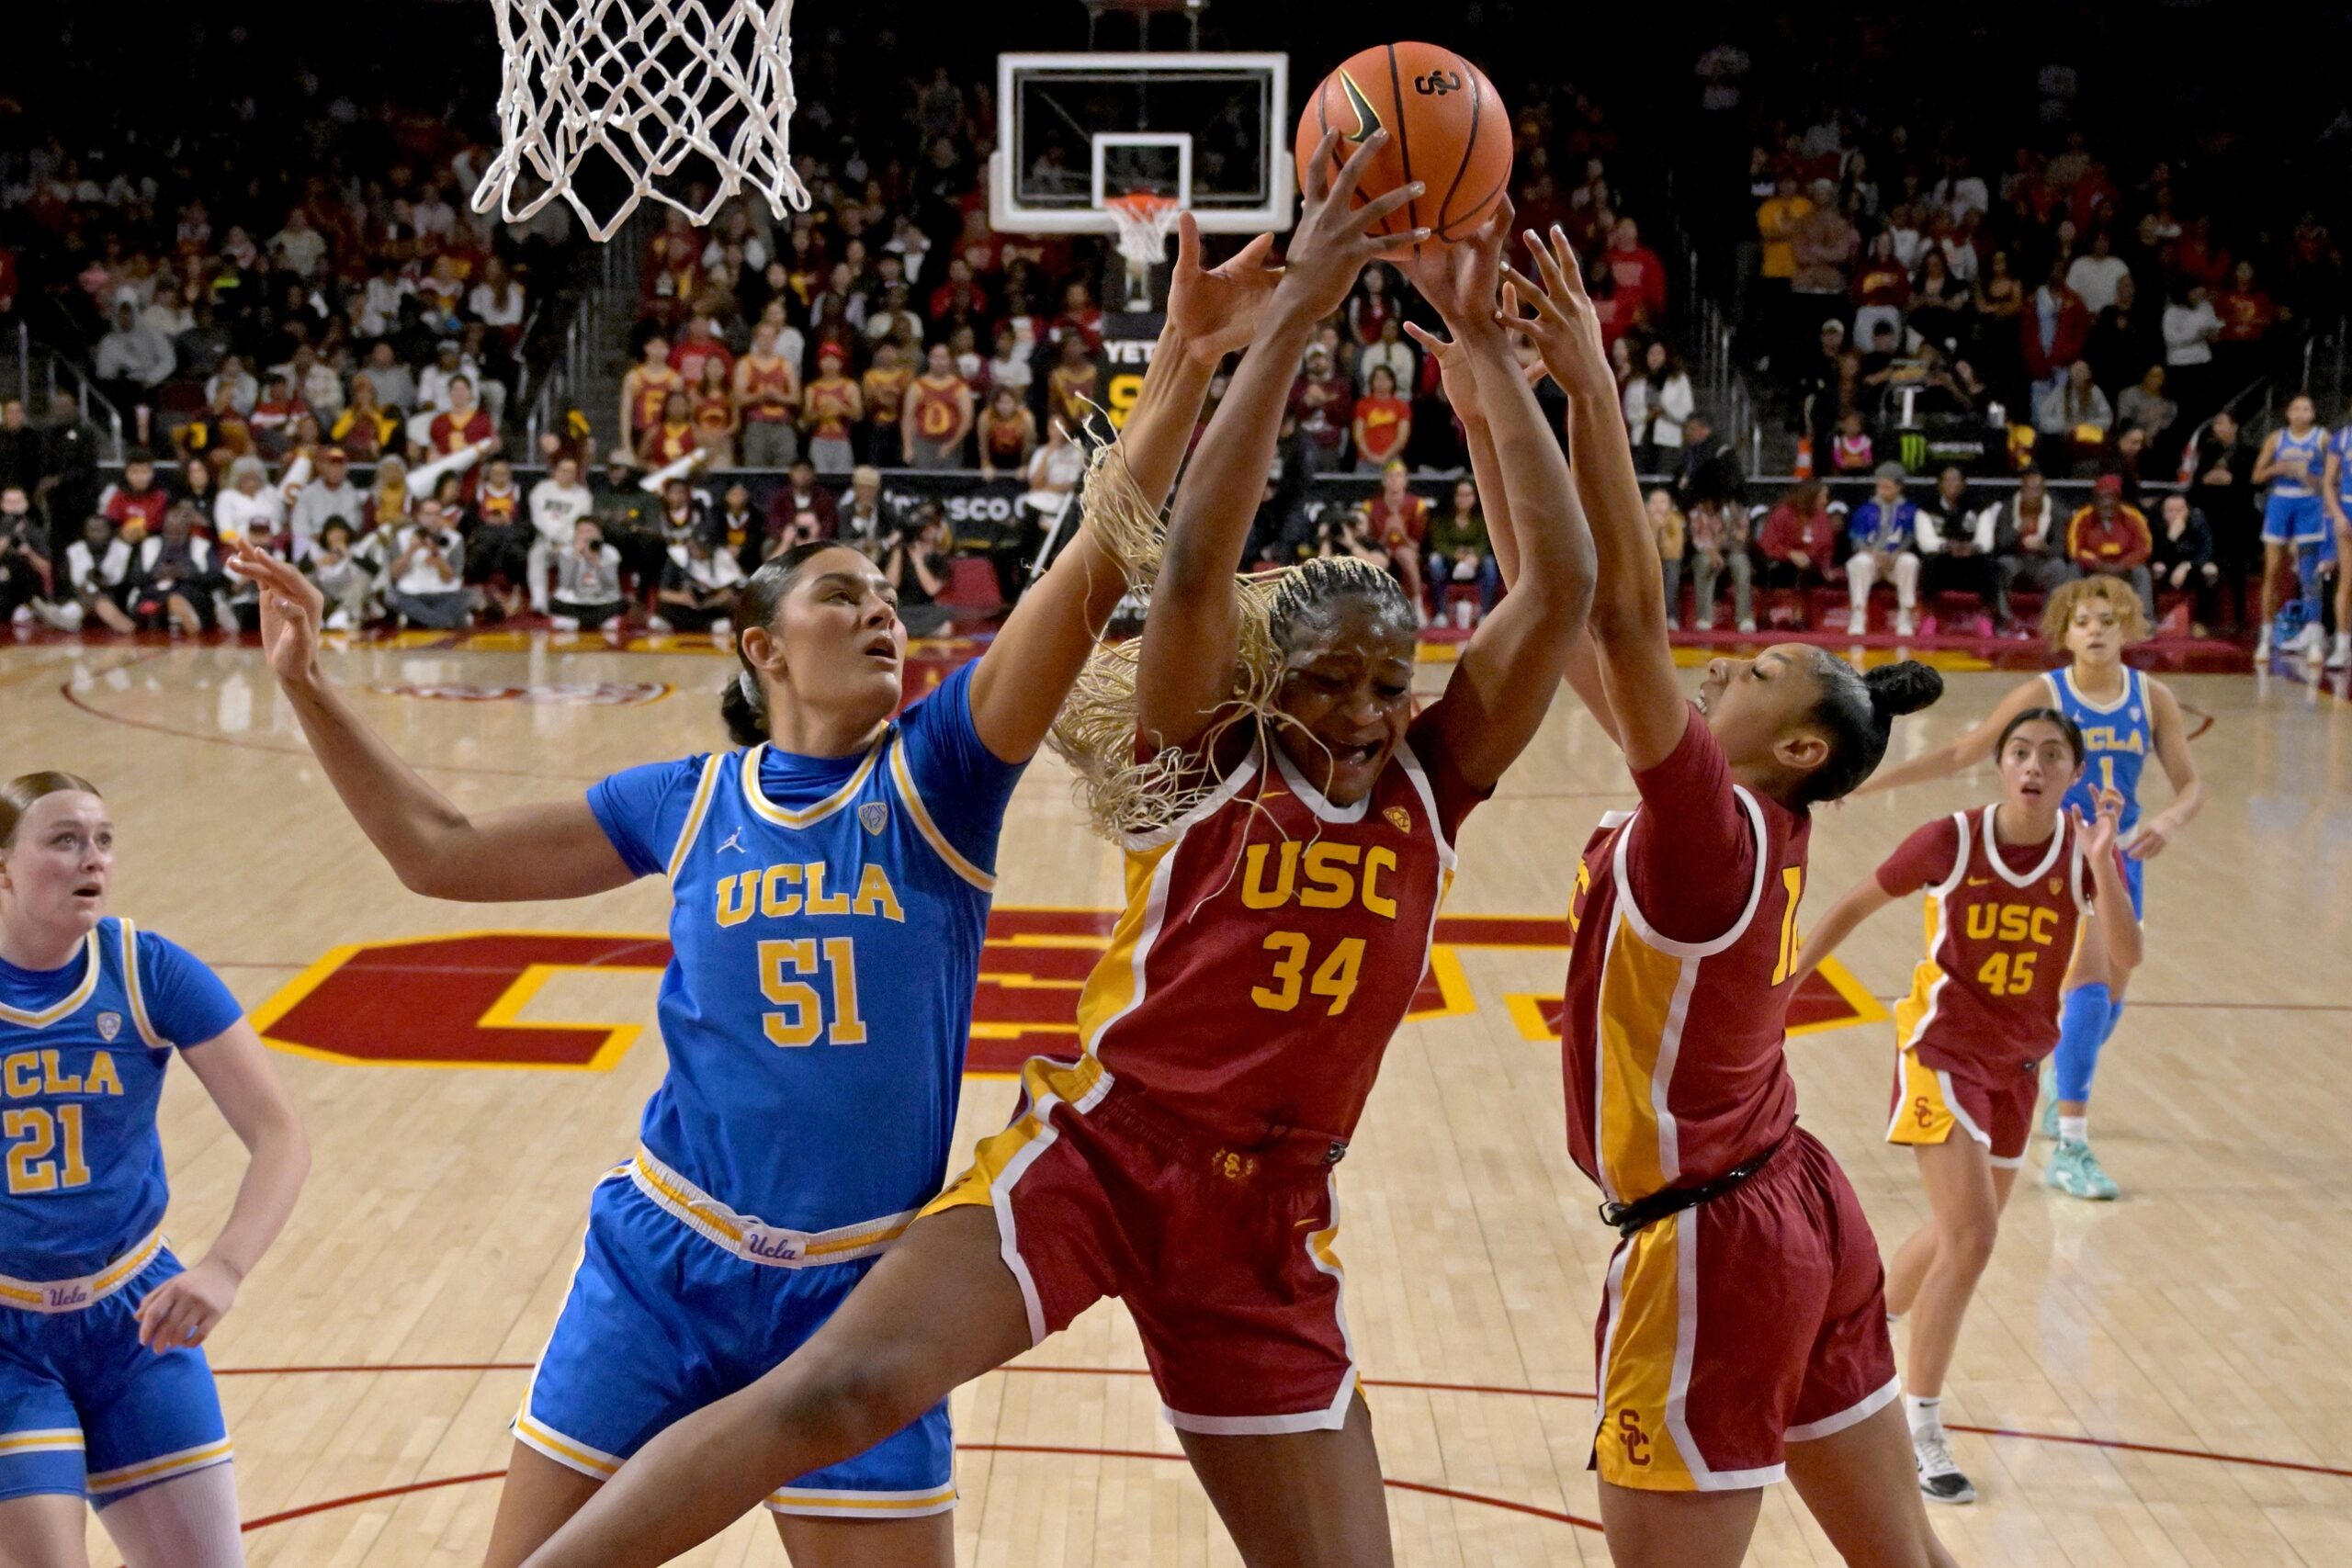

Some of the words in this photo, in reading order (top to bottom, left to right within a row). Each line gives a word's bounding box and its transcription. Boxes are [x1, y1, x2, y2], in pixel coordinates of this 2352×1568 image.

[1103, 340, 1158, 364] YET
[716, 861, 905, 929] UCLA
[1241, 840, 1396, 919] USC
[1771, 865, 1801, 987] 1
[1966, 903, 2058, 945] USC
[757, 936, 867, 1047] 51
[1251, 931, 1367, 1016] 34
[1977, 952, 2038, 996] 45
[0, 1049, 125, 1099] CLA
[3, 1104, 91, 1194] 21
[750, 1233, 797, 1260] Ucla
[49, 1286, 88, 1307] Ucla
